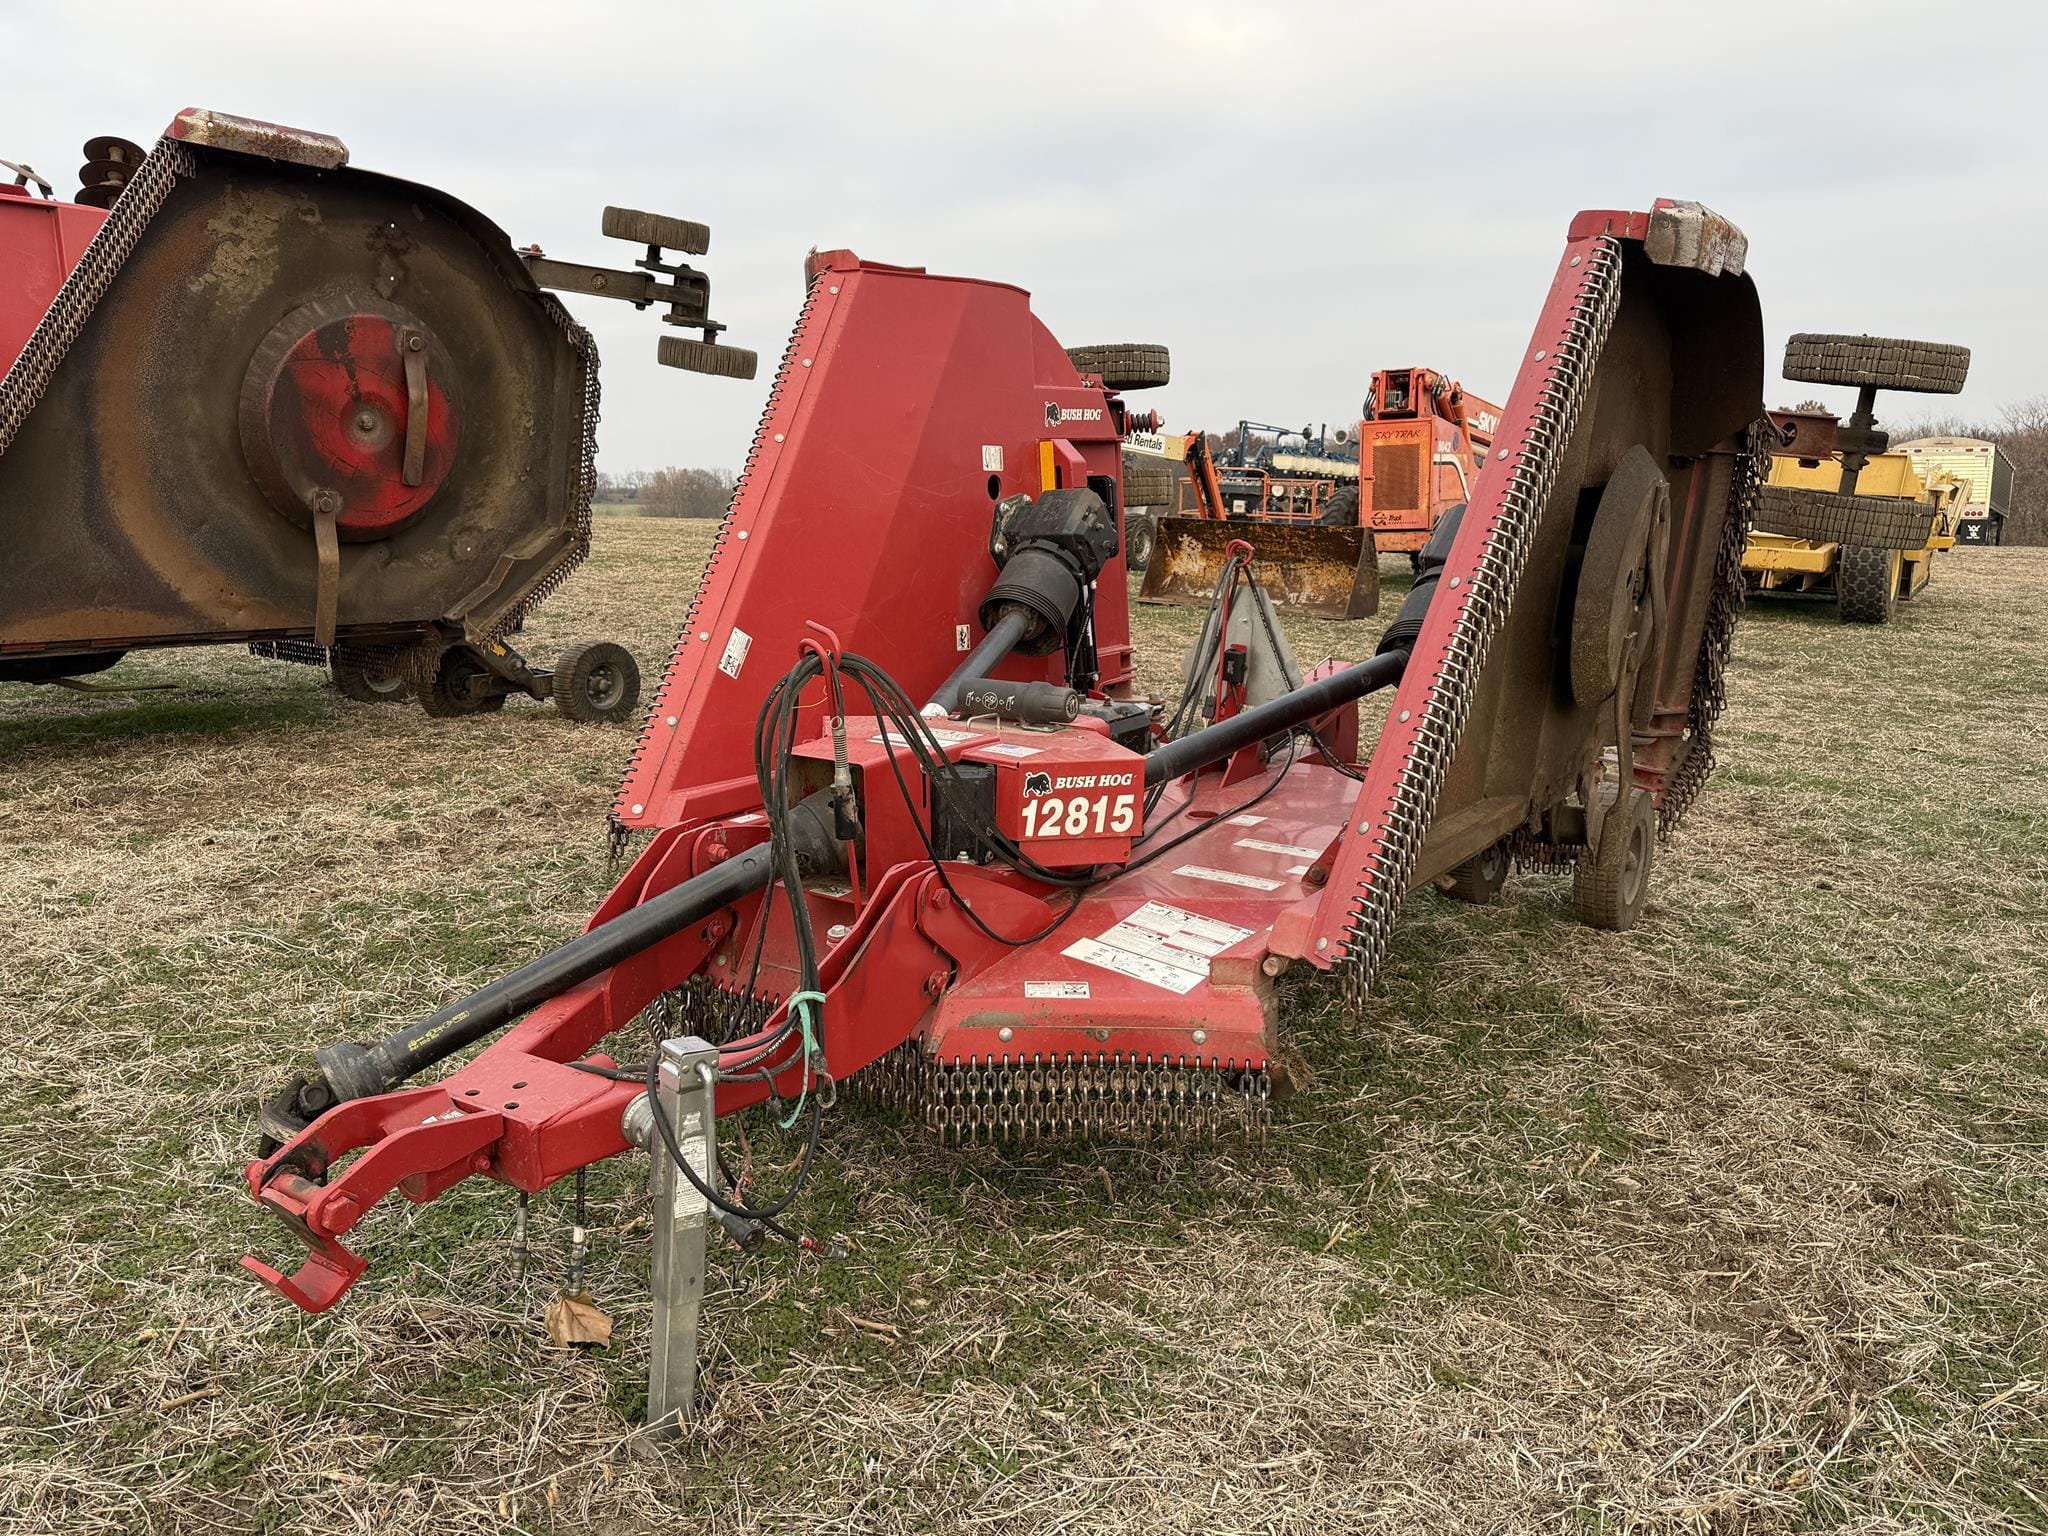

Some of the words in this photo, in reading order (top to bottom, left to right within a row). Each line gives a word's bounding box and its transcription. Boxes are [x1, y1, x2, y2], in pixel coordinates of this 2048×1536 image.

[1061, 408, 1082, 421] BUSH
[1083, 408, 1102, 421] HOG
[1478, 411, 1501, 435] SKY
[1134, 433, 1163, 451] Rentals
[1055, 775, 1097, 789] BUSH
[1098, 773, 1133, 787] HOG
[1021, 794, 1135, 837] 12815
